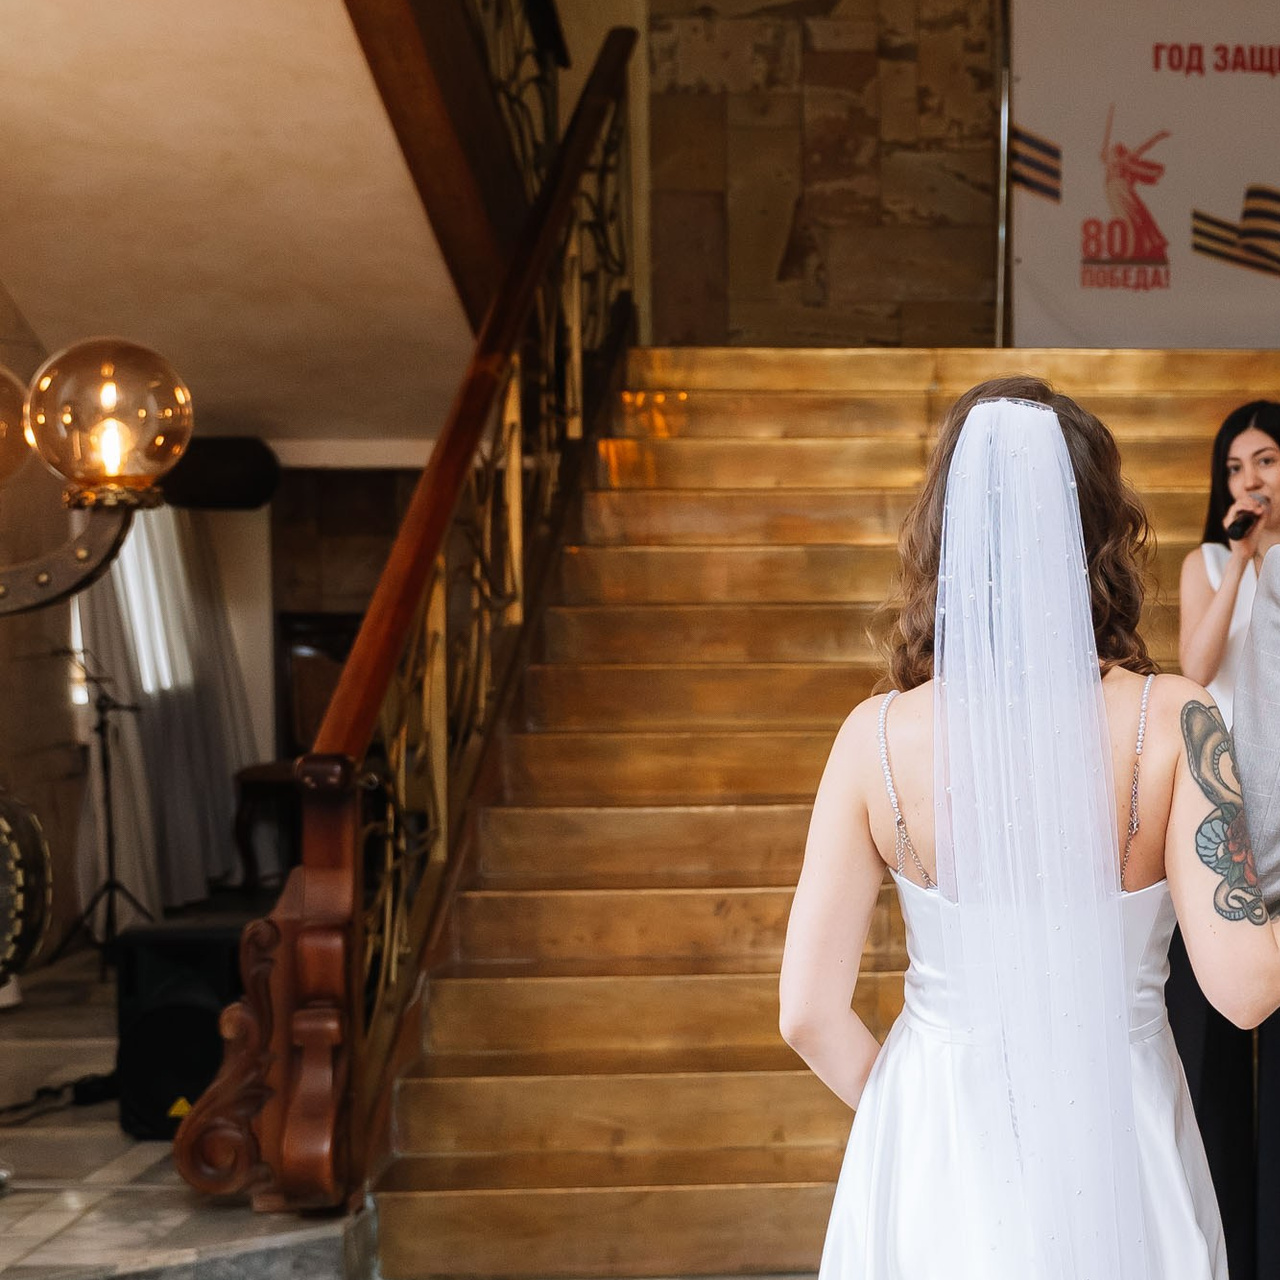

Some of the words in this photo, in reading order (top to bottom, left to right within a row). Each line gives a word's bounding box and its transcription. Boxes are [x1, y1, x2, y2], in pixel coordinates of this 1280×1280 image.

[1153, 42, 1205, 78] ГОД
[1082, 218, 1128, 258] 80
[1082, 266, 1171, 291] ПОБЕДА!
